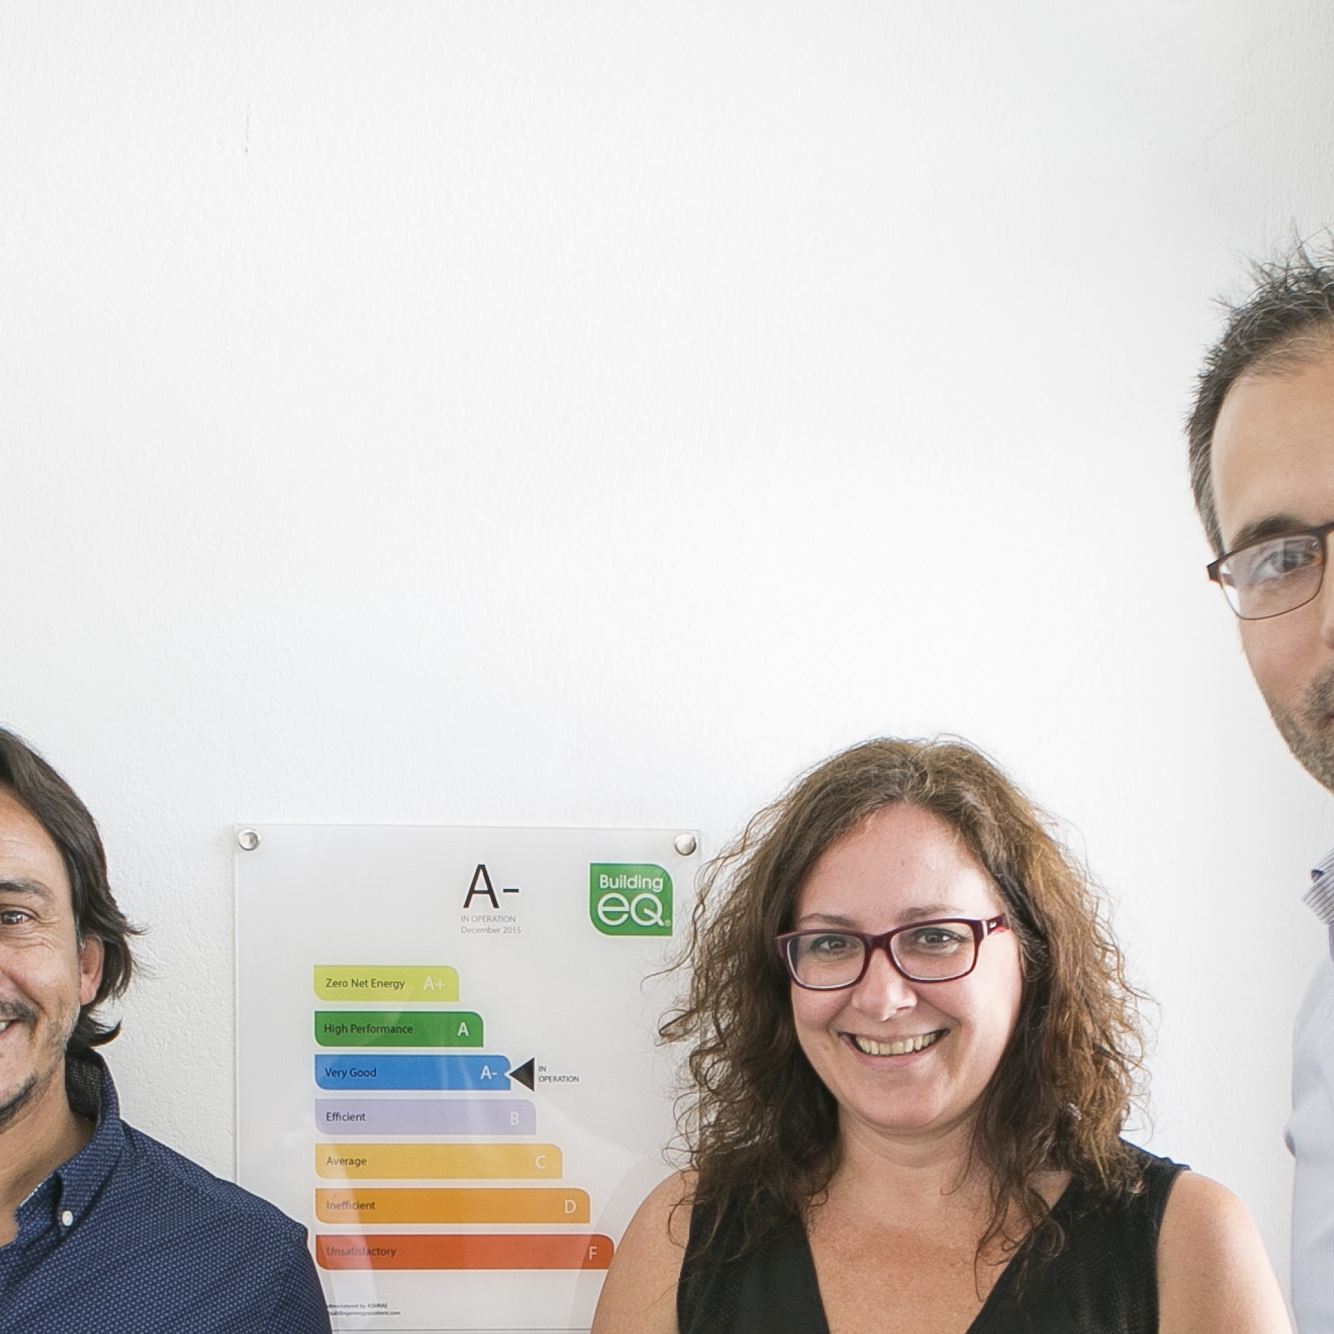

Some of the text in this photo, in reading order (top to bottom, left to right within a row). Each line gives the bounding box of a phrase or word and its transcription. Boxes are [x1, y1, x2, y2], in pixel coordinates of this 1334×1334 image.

[463, 863, 520, 909] A-
[599, 874, 664, 892] Building
[461, 915, 517, 923] IN OPERATION
[461, 926, 522, 934] December 2015
[325, 978, 405, 991] Zero Net Energy
[422, 976, 446, 991] A+
[324, 1023, 414, 1036] High Performance
[457, 1022, 469, 1037] A
[325, 1067, 377, 1080] Very Good
[480, 1065, 498, 1080] A-
[538, 1075, 579, 1083] OPERATION
[326, 1112, 366, 1122] Efficient
[510, 1111, 520, 1126] B
[326, 1156, 367, 1168] Average
[535, 1155, 546, 1170] C
[326, 1200, 376, 1211] Inefficient
[564, 1200, 577, 1214] D
[326, 1246, 397, 1258] Unsatisfactory
[588, 1247, 598, 1260] F
